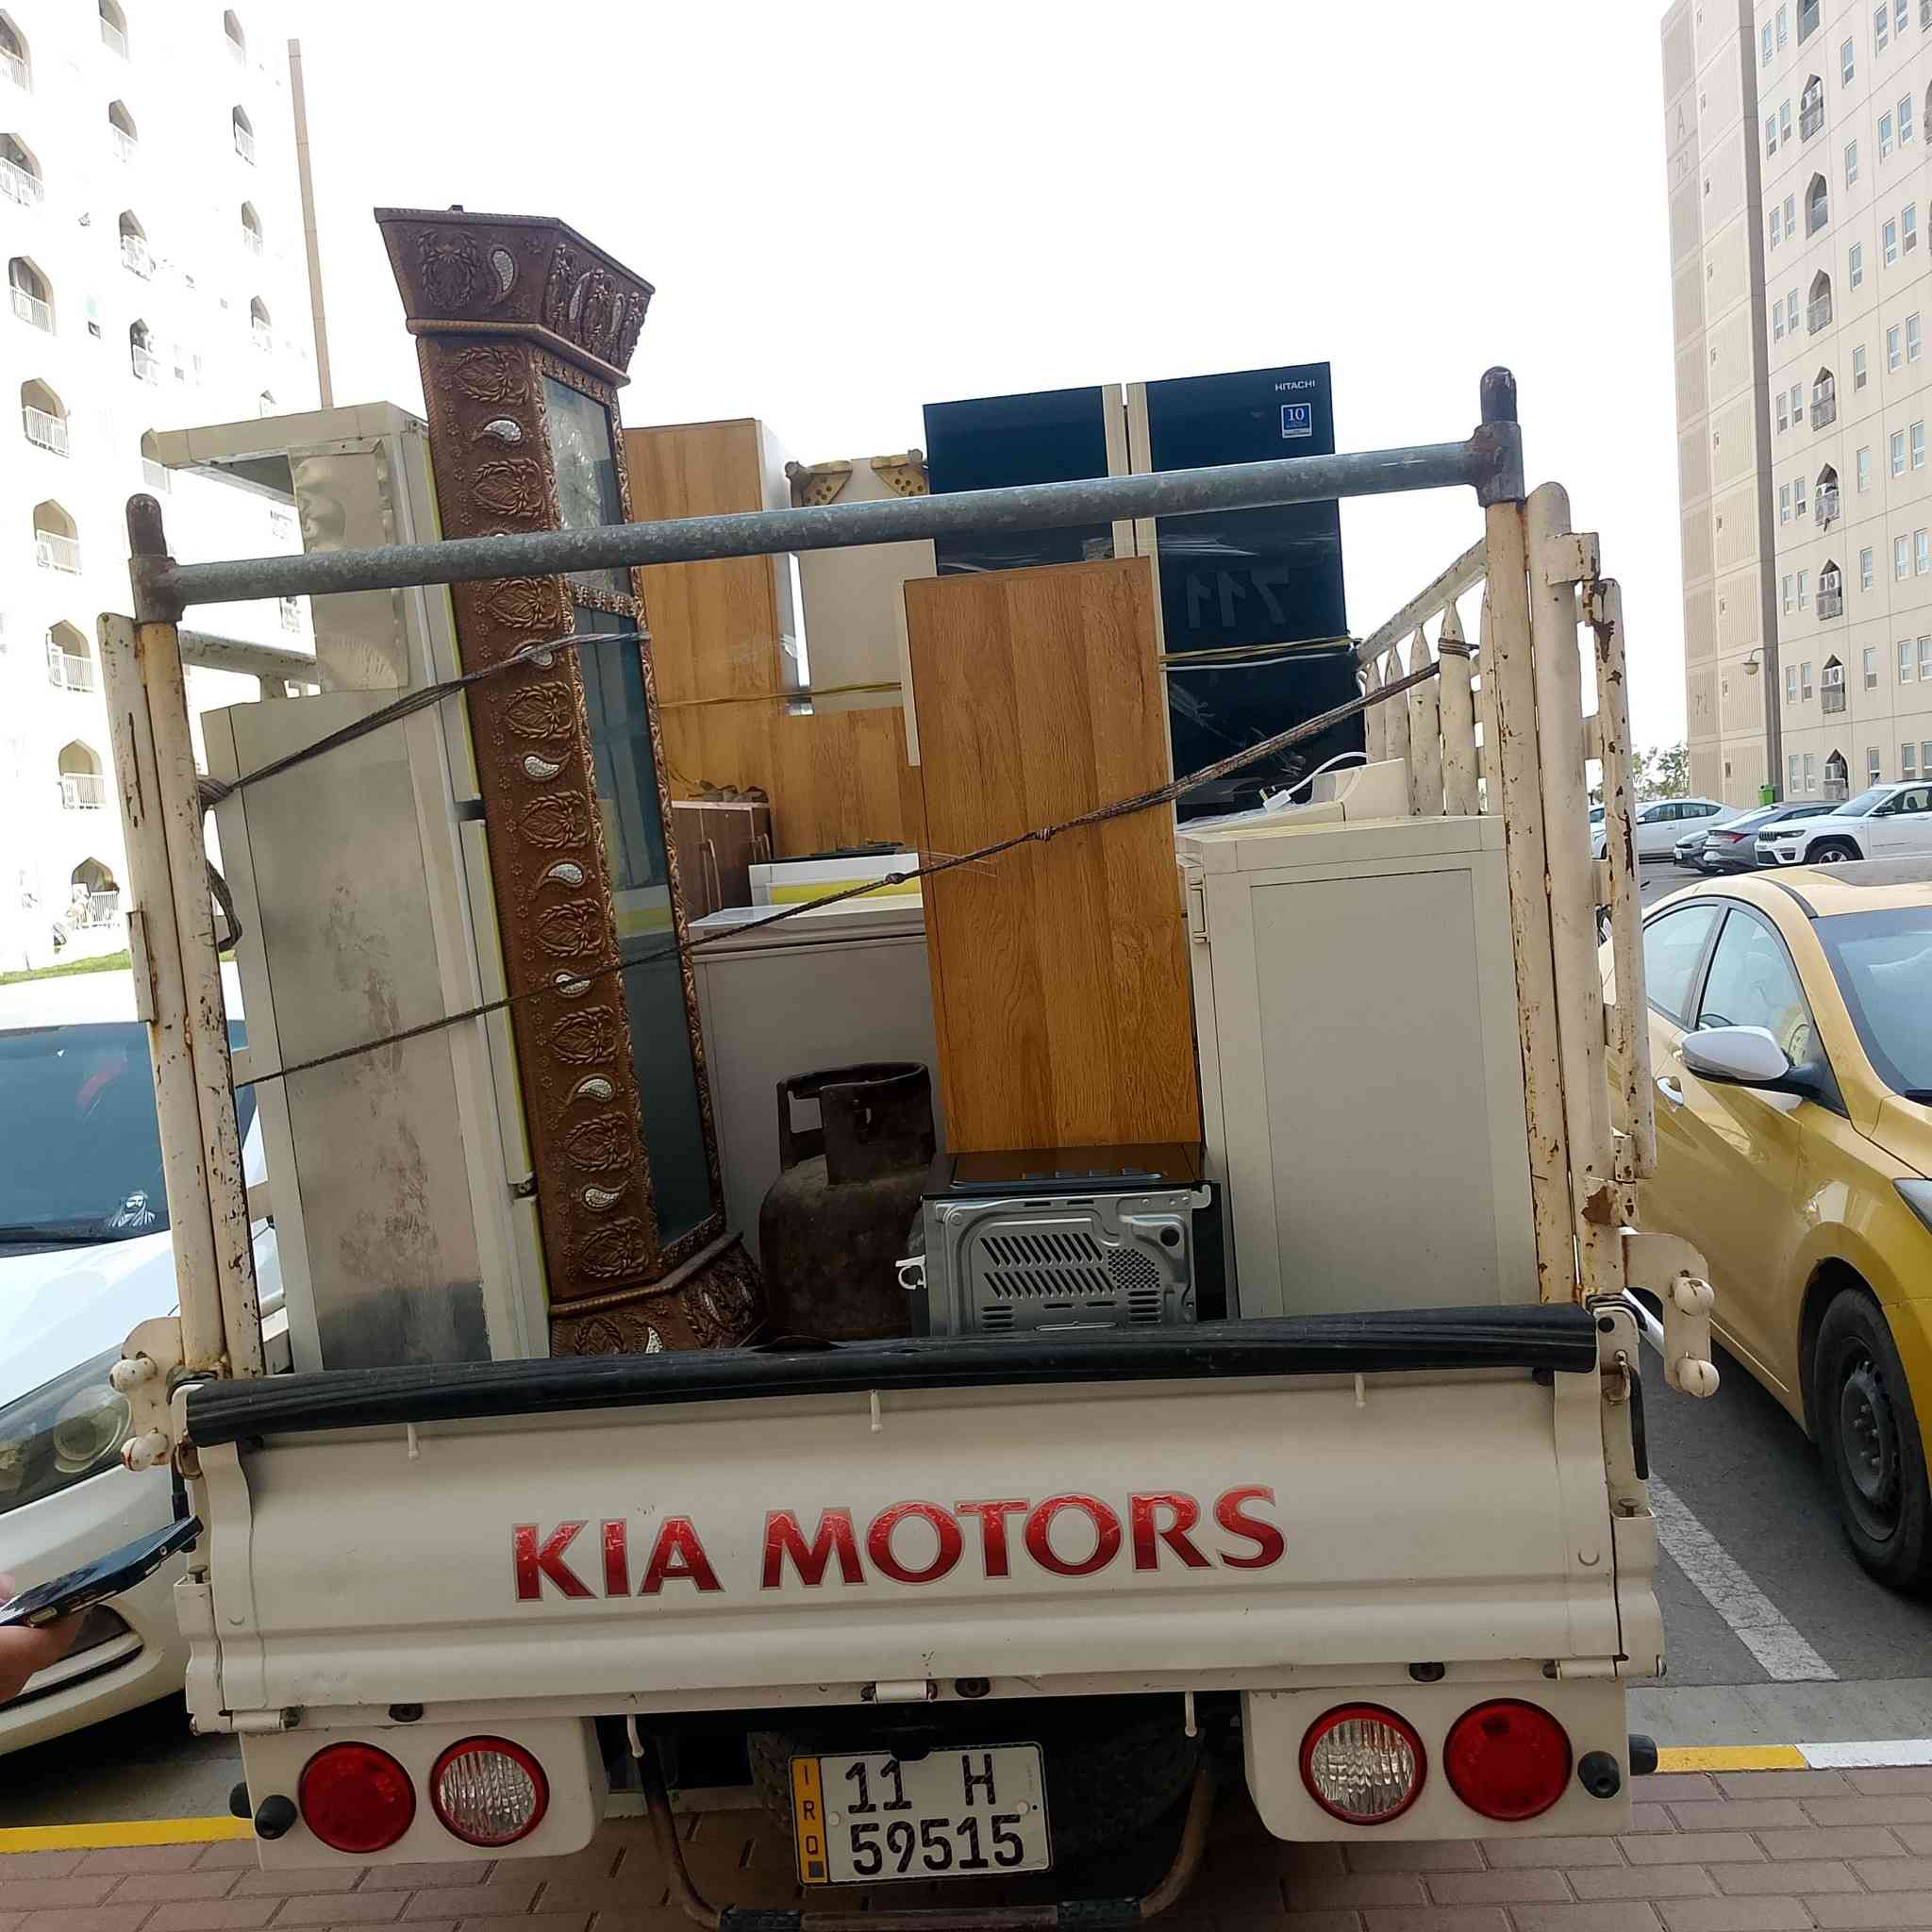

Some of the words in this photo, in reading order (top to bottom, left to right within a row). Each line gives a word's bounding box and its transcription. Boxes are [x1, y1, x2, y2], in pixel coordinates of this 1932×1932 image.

[1274, 379, 1316, 391] HITACHI
[1287, 407, 1306, 422] 10
[513, 1515, 724, 1603] KIA
[759, 1484, 1287, 1589] MOTORS
[844, 1759, 912, 1814] 11
[961, 1754, 996, 1806] H
[849, 1814, 1024, 1875] 59515
